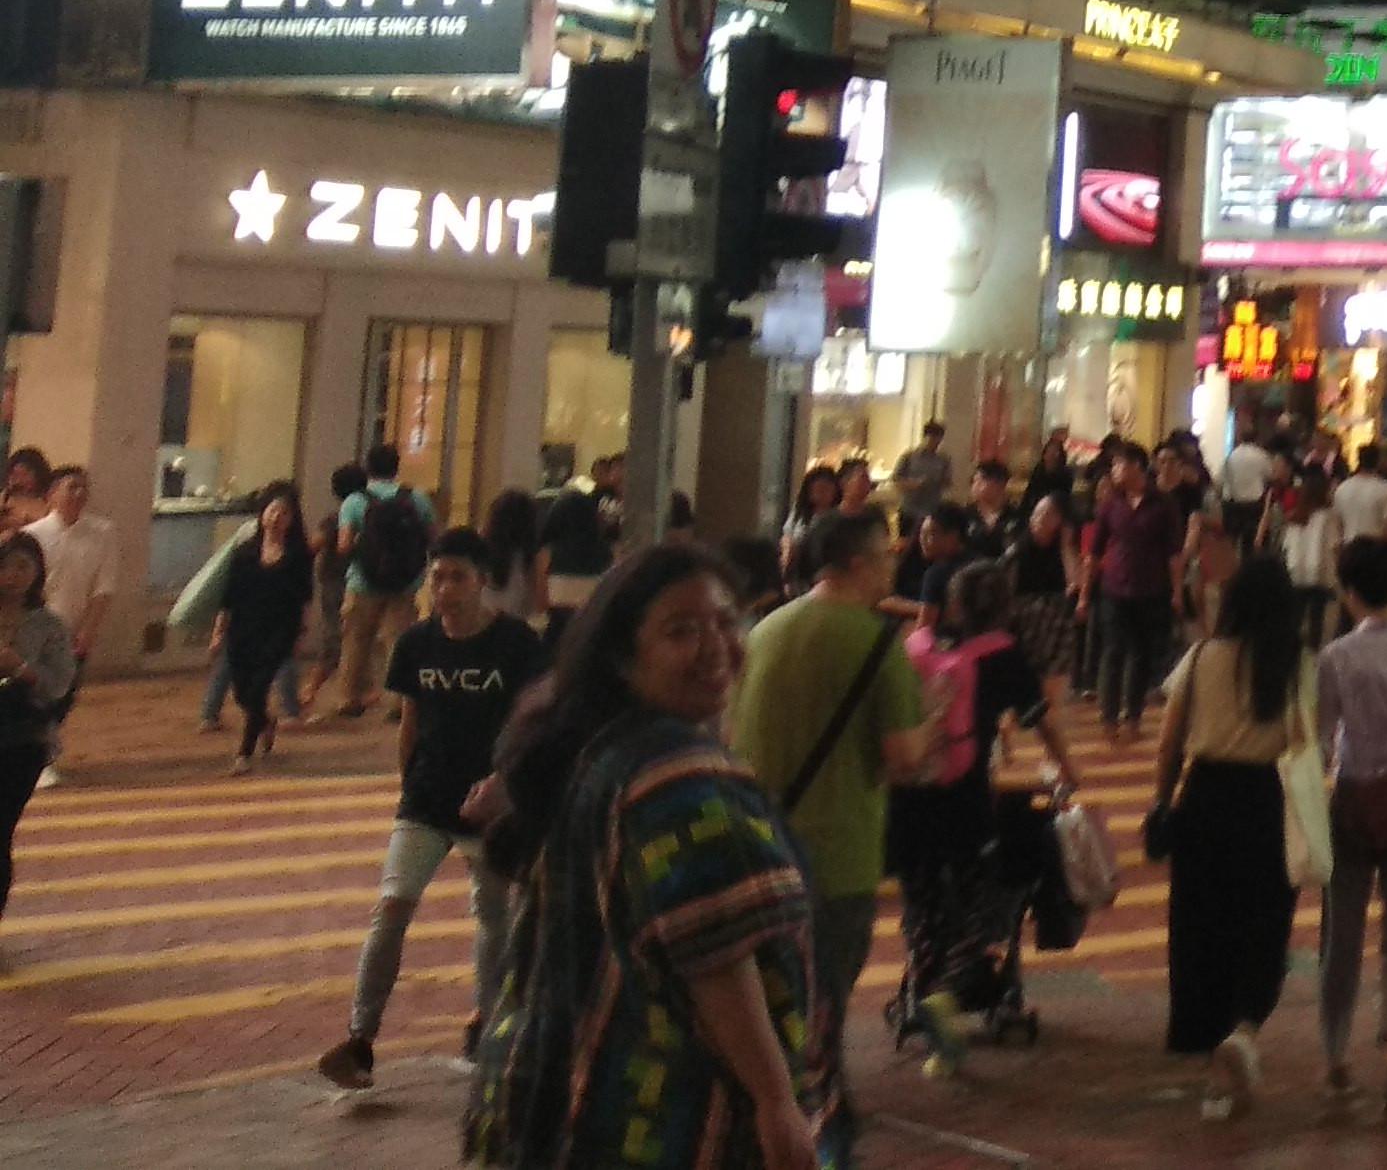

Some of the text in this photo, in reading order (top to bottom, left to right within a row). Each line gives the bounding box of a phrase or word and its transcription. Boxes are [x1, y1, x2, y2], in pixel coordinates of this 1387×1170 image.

[205, 19, 258, 38] WATCH
[261, 17, 379, 38] MANUFACTURE
[381, 16, 428, 36] SINCE
[418, 668, 504, 690] RVCA
